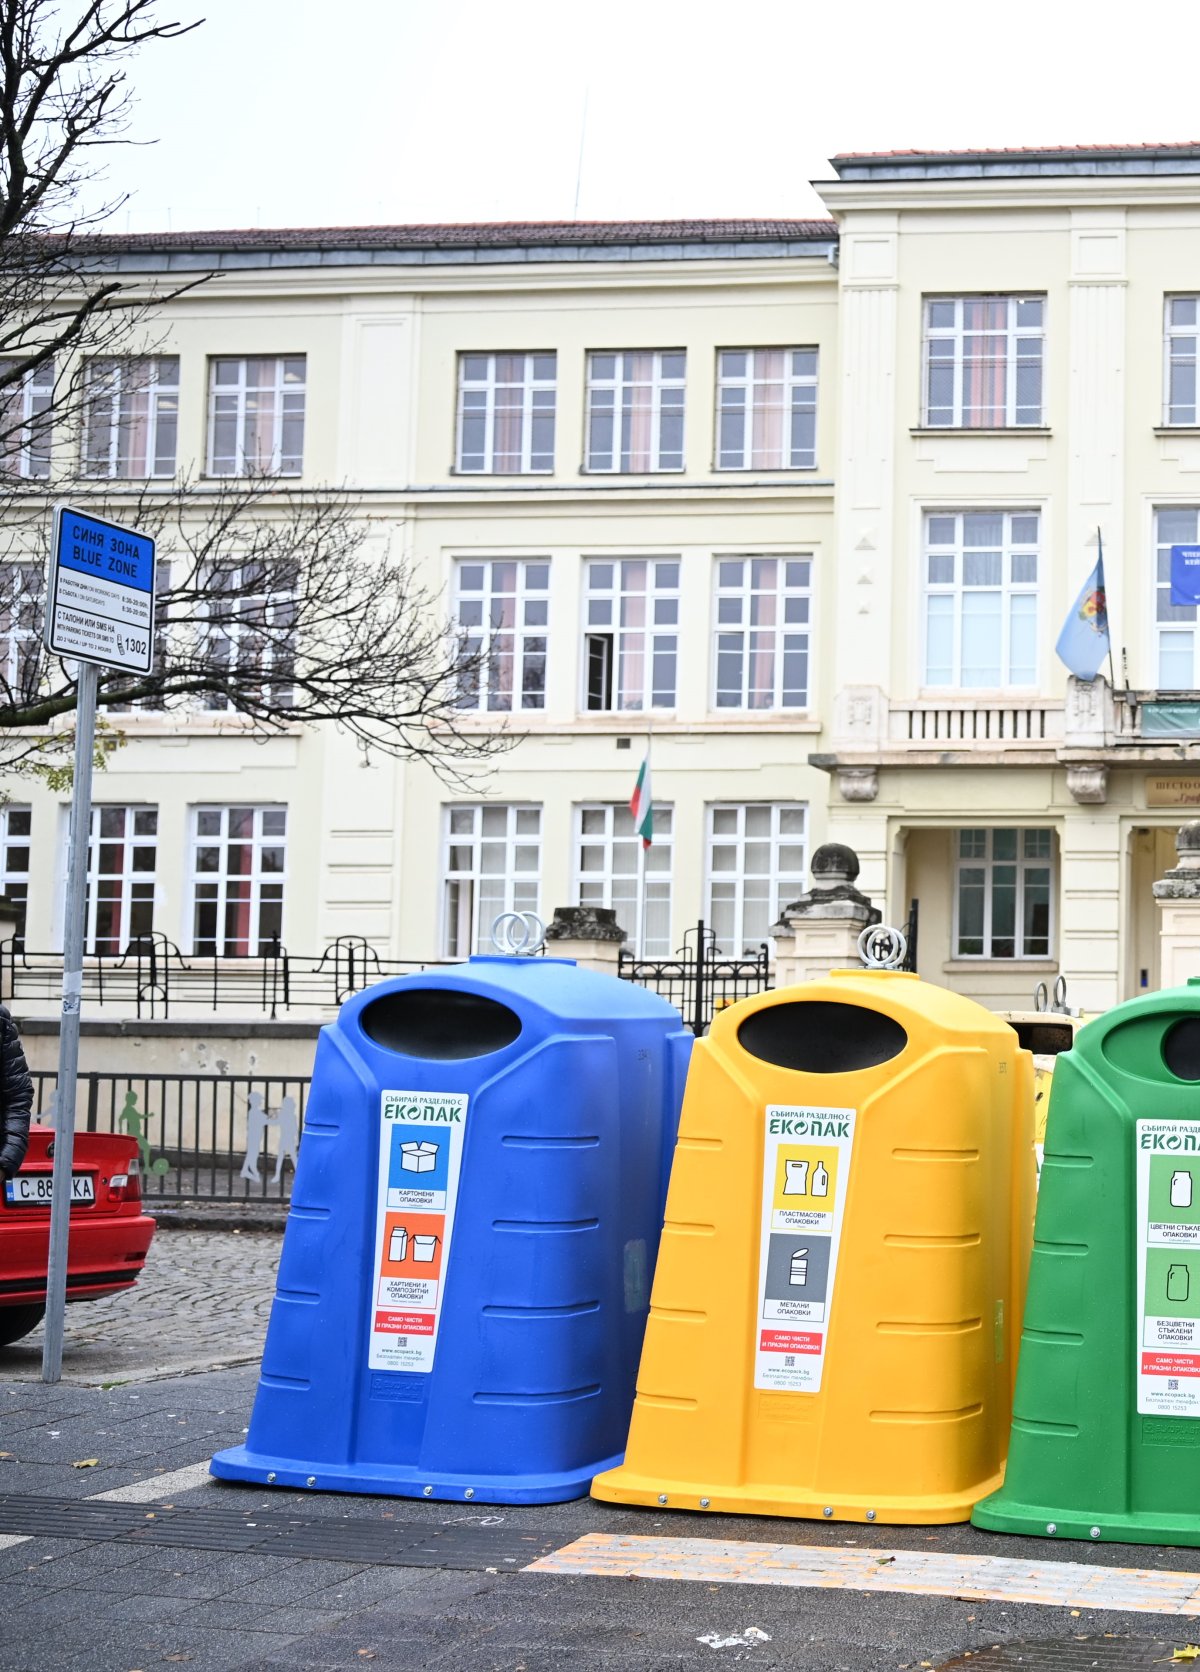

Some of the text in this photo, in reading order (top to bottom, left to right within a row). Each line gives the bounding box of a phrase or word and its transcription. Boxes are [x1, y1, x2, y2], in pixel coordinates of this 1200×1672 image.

[72, 526, 140, 559] СИНЯ ЗОНА
[73, 546, 137, 578] BLUE ZONE
[62, 611, 83, 625] ТАЛОНИ
[84, 618, 95, 628] ИЛИ
[96, 621, 106, 631] SMS
[108, 624, 114, 633] НА
[65, 625, 80, 634] PARKING
[124, 636, 146, 655] 1302
[1156, 781, 1193, 790] ШЕСТО
[384, 1104, 462, 1122] ЕКОПАК
[769, 1119, 850, 1138] ЕКОПАК
[20, 1180, 29, 1198] C
[73, 1179, 91, 1197] KA
